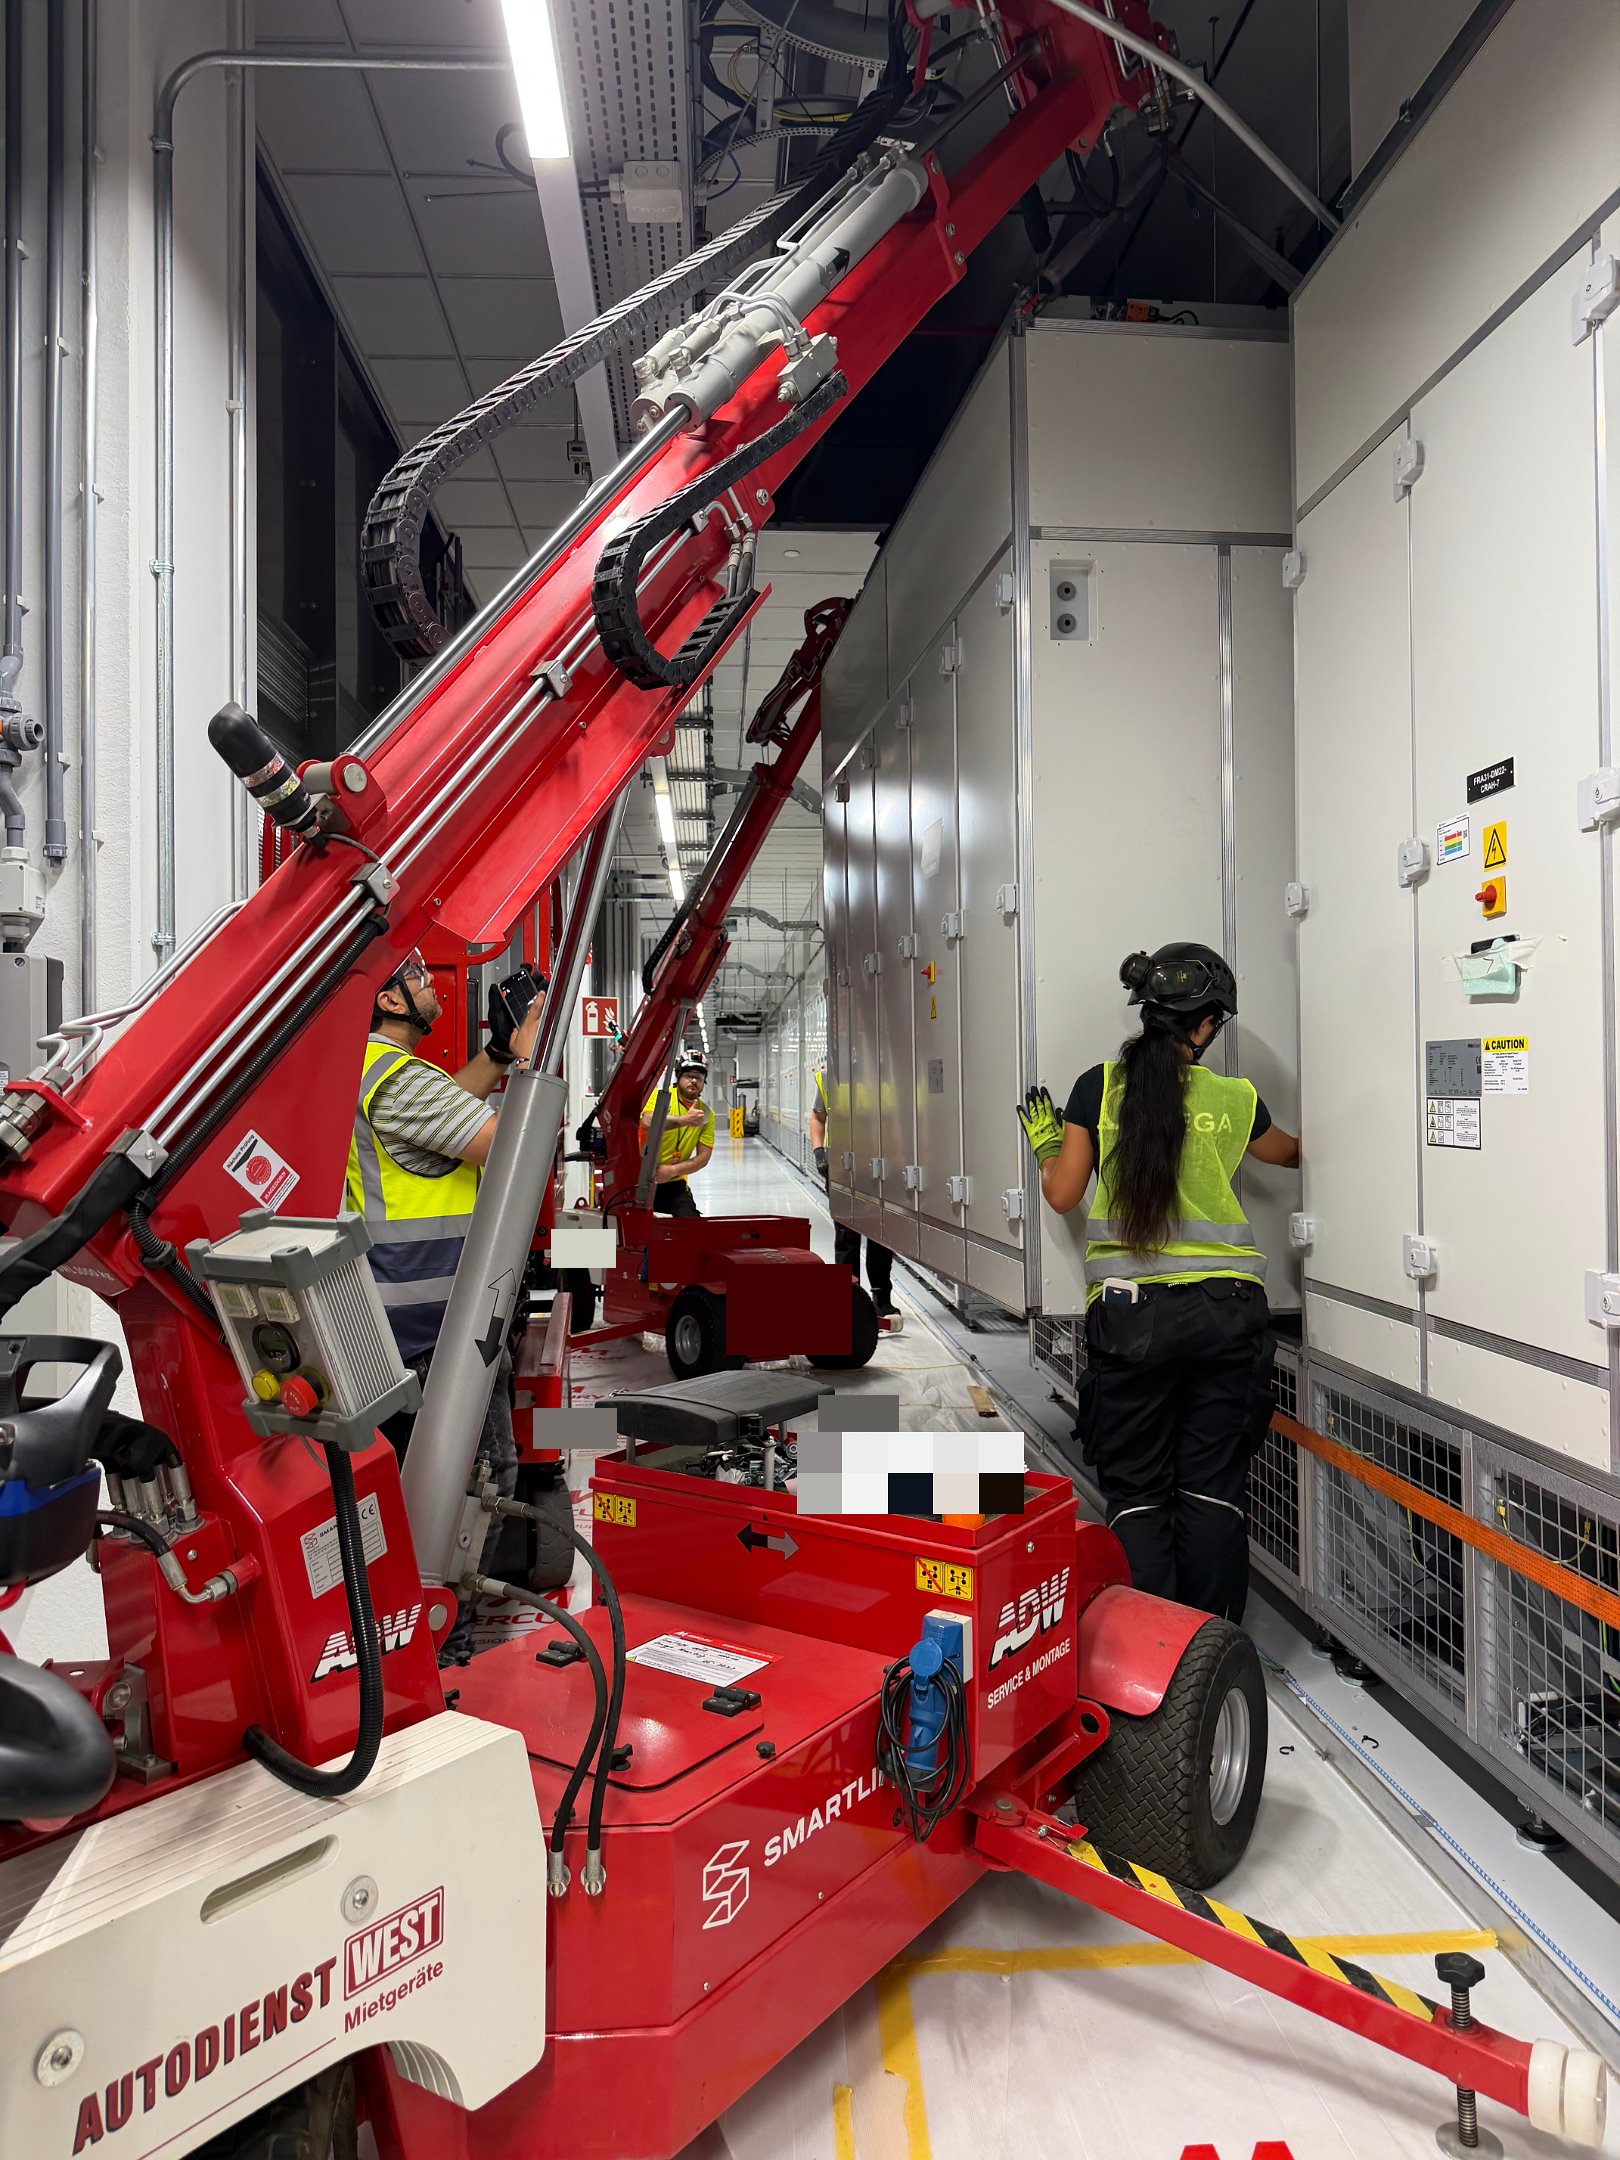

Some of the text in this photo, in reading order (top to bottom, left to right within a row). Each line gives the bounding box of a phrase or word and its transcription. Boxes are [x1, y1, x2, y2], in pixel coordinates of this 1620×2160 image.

[1491, 1038, 1525, 1050] CAUTION
[988, 1567, 1070, 1672] ADW
[987, 1638, 1071, 1710] SERVICE & MONTAGE
[72, 1898, 439, 2157] AUTODIENST WEST
[344, 1961, 444, 2034] Mietgeräte
